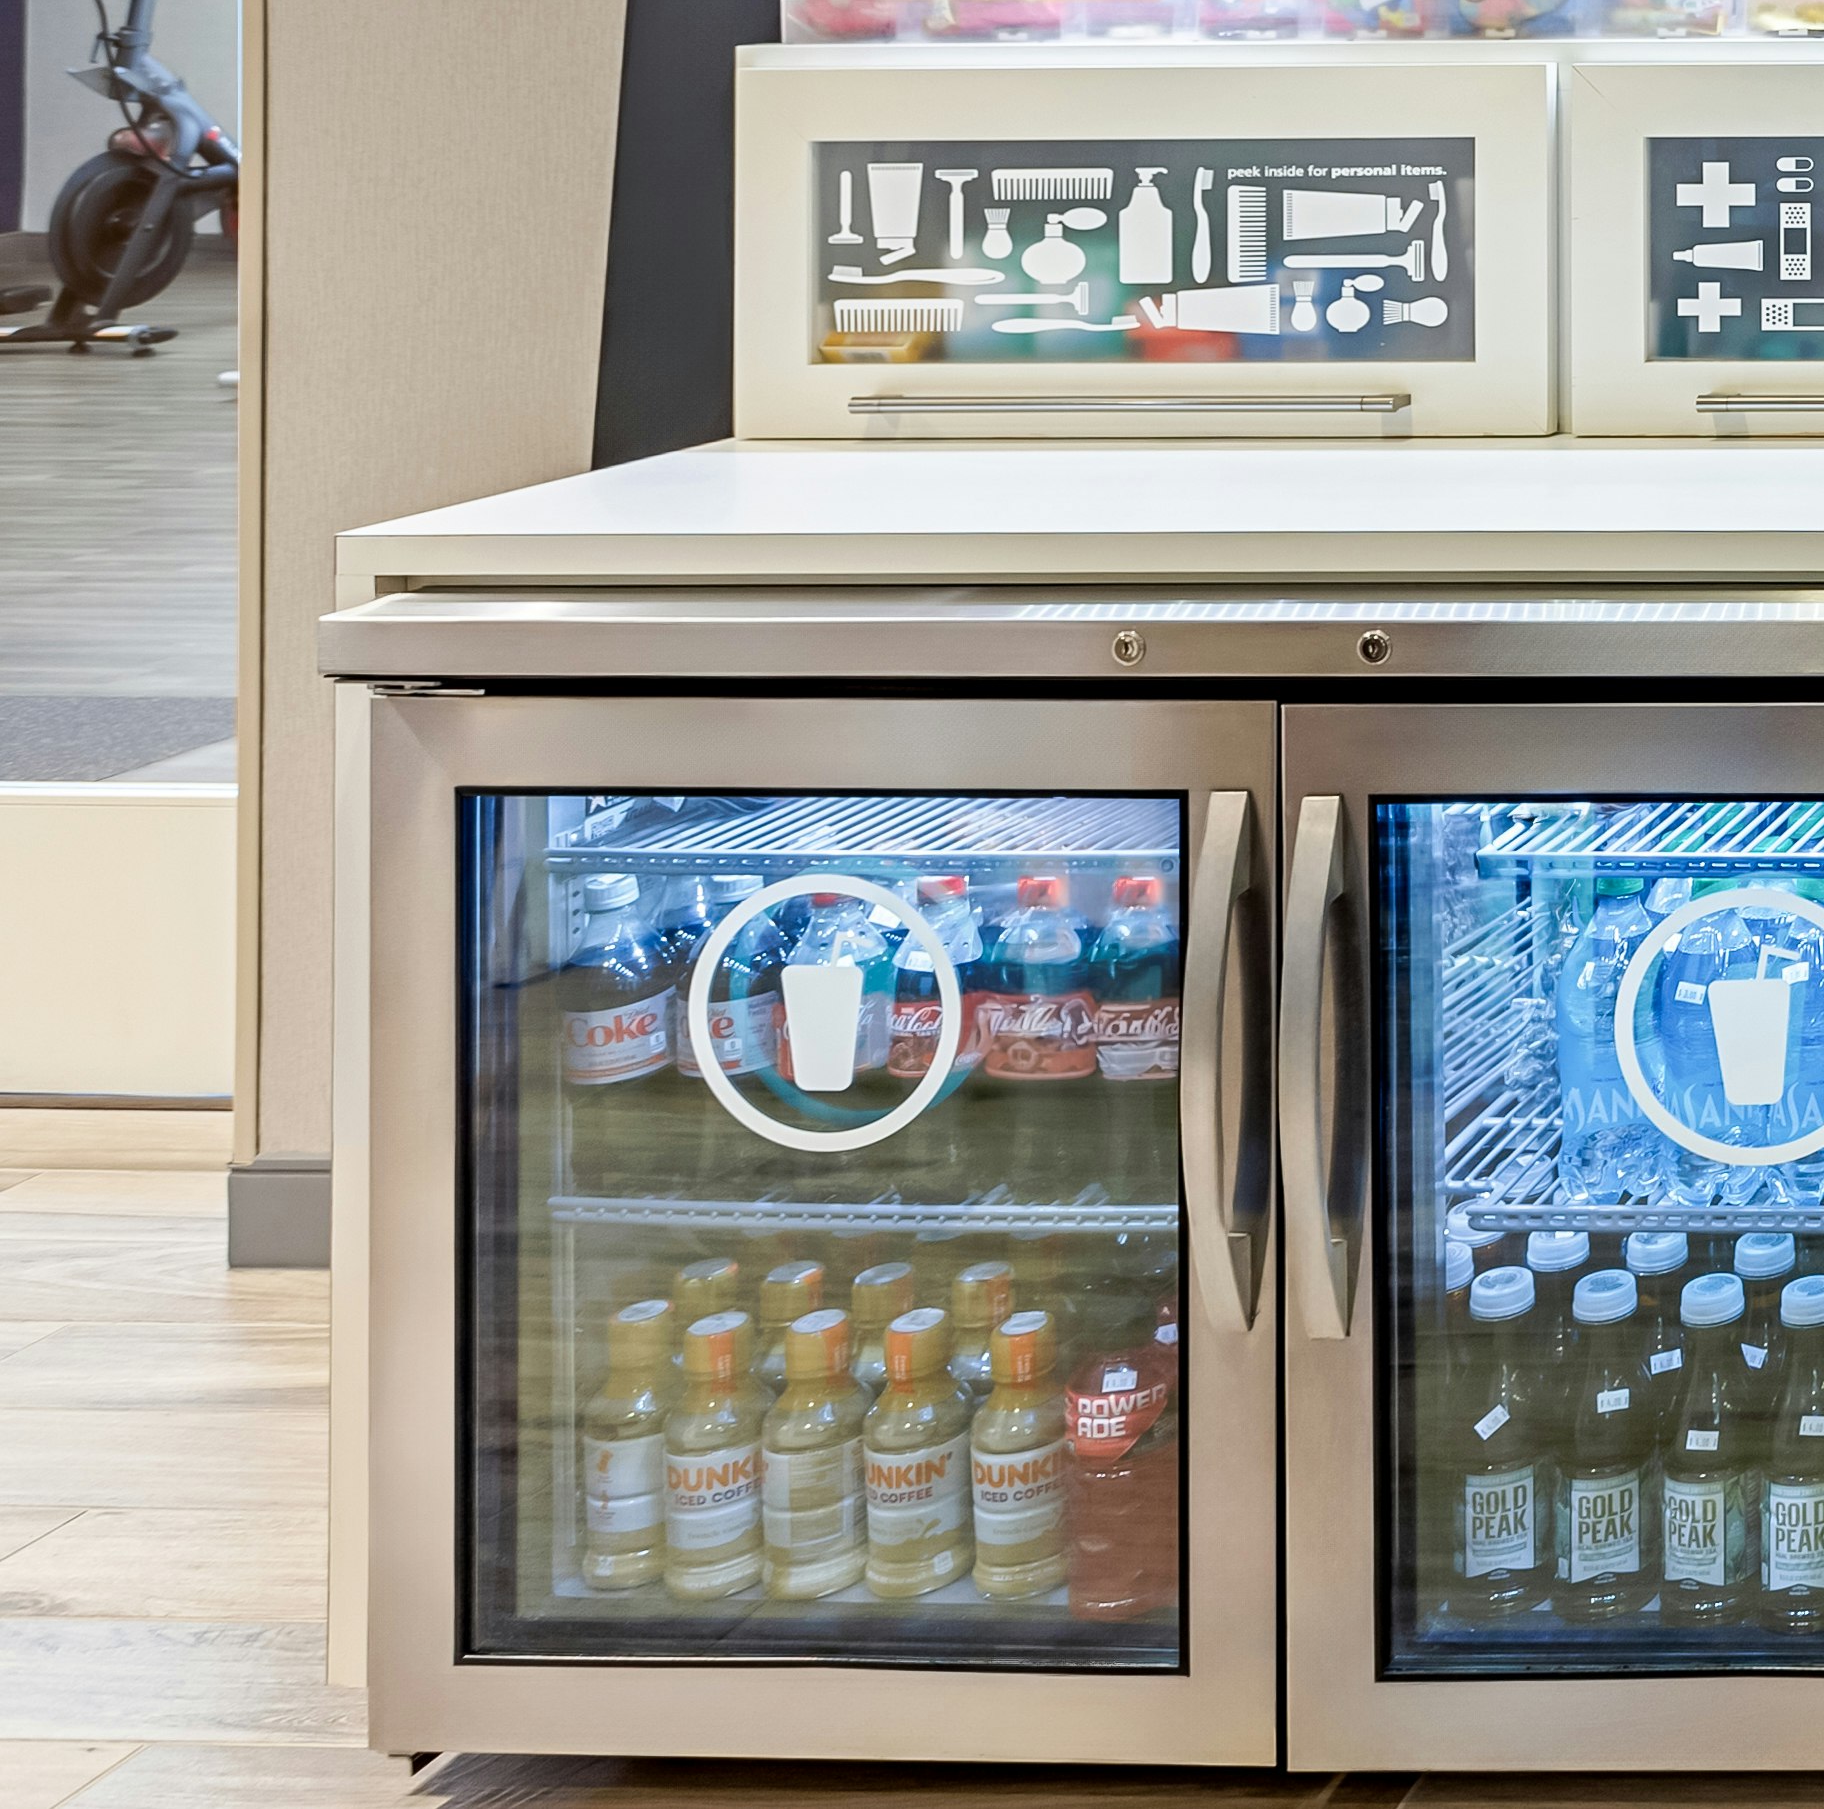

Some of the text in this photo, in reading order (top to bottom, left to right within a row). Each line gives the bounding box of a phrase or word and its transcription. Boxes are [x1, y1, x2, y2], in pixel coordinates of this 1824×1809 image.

[1227, 163, 1448, 179] peek inside for personal items.
[674, 1492, 707, 1507] ICED
[880, 1485, 934, 1504] COFFEE
[1471, 1484, 1528, 1517] GOLD
[1577, 1487, 1635, 1520] GOLD
[1667, 1494, 1718, 1524] GOLD
[1472, 1514, 1530, 1540] PEAK
[1577, 1517, 1636, 1545] PEAK
[1668, 1522, 1719, 1549] PEAK
